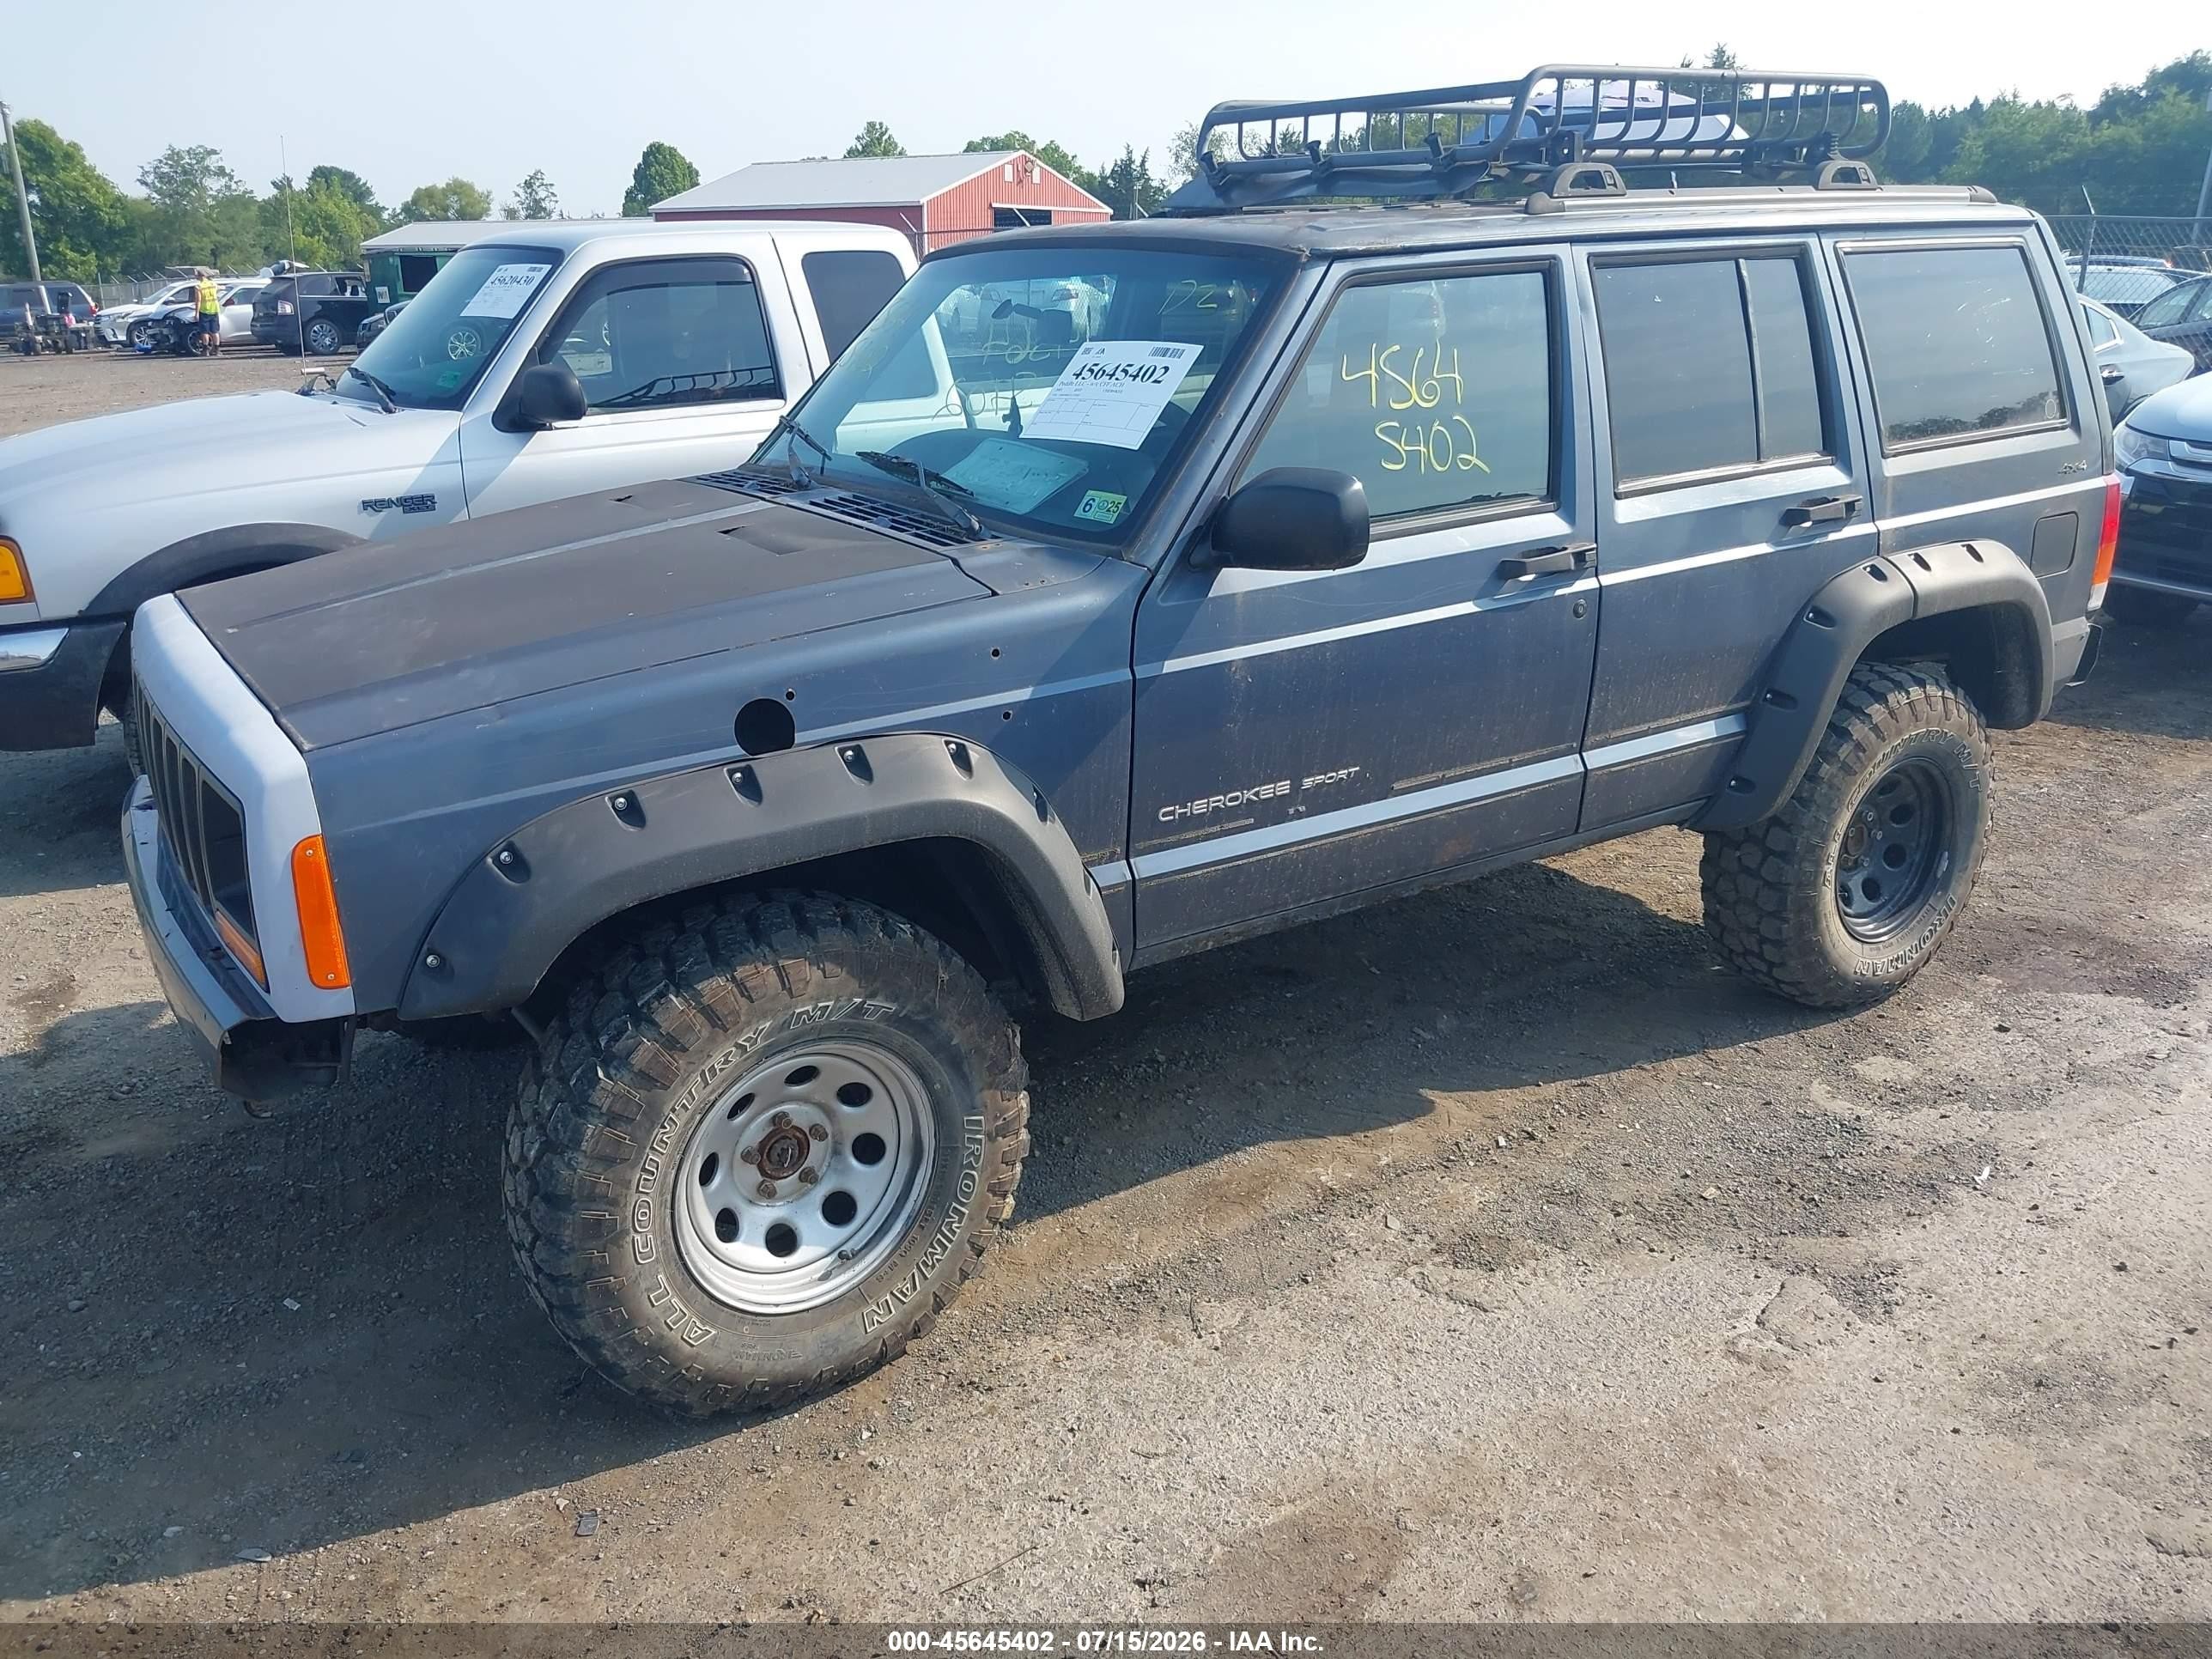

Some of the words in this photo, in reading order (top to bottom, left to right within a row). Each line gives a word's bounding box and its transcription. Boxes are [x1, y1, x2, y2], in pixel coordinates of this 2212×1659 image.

[1072, 362, 1170, 385] 45645402
[362, 493, 437, 513] RANGER
[1082, 497, 1096, 514] 6
[1106, 501, 1122, 514] 25
[1953, 740, 1984, 793] M/T
[1158, 780, 1291, 823] CHEROKEE
[1300, 766, 1360, 790] SPORT
[1854, 893, 1958, 976] IRONMAN
[789, 997, 897, 1030] M/T
[631, 1020, 773, 1265] COUNTRY
[861, 1114, 986, 1335] IRONMAN
[647, 1274, 718, 1346] ALL
